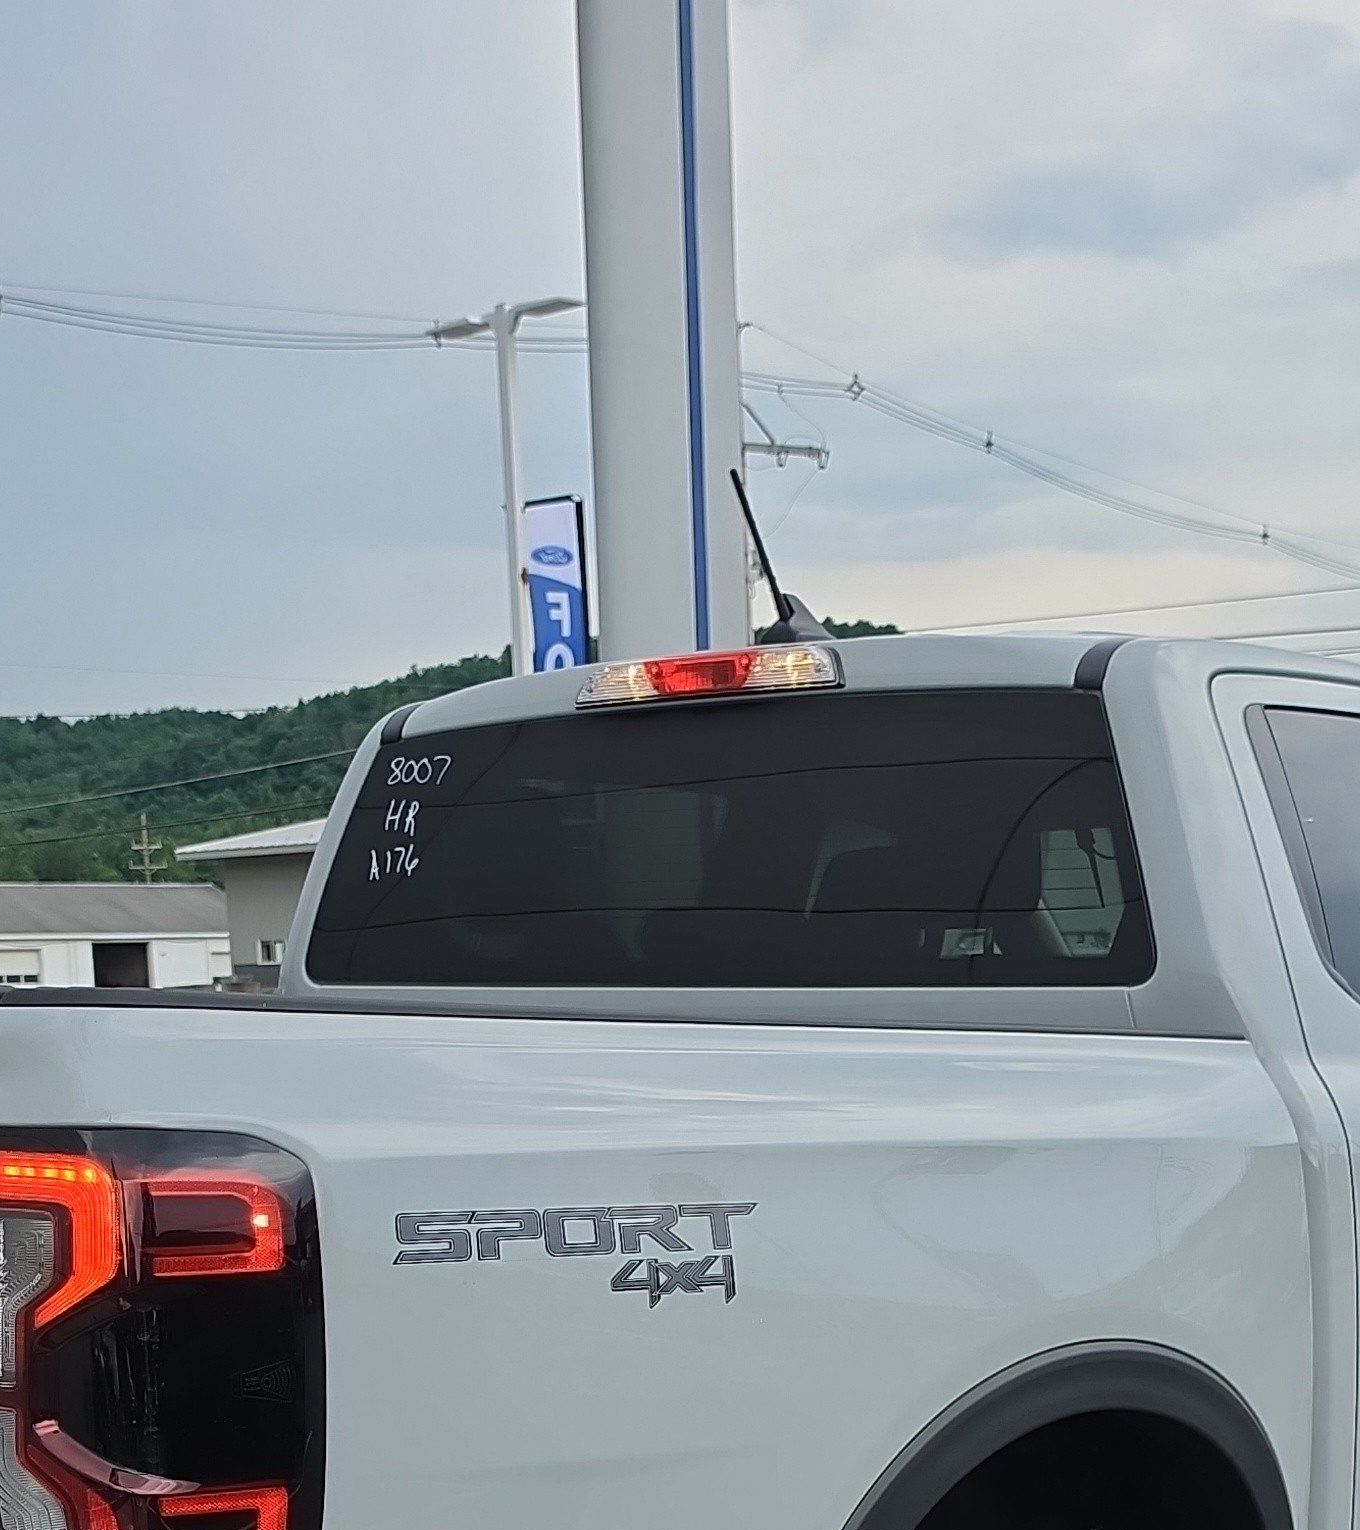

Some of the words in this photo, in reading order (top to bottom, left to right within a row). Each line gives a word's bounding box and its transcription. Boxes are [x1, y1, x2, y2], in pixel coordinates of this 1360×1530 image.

[387, 755, 452, 786] 8007
[384, 798, 420, 837] HR
[392, 1202, 760, 1266] SPORT
[610, 1254, 737, 1309] 4x4
